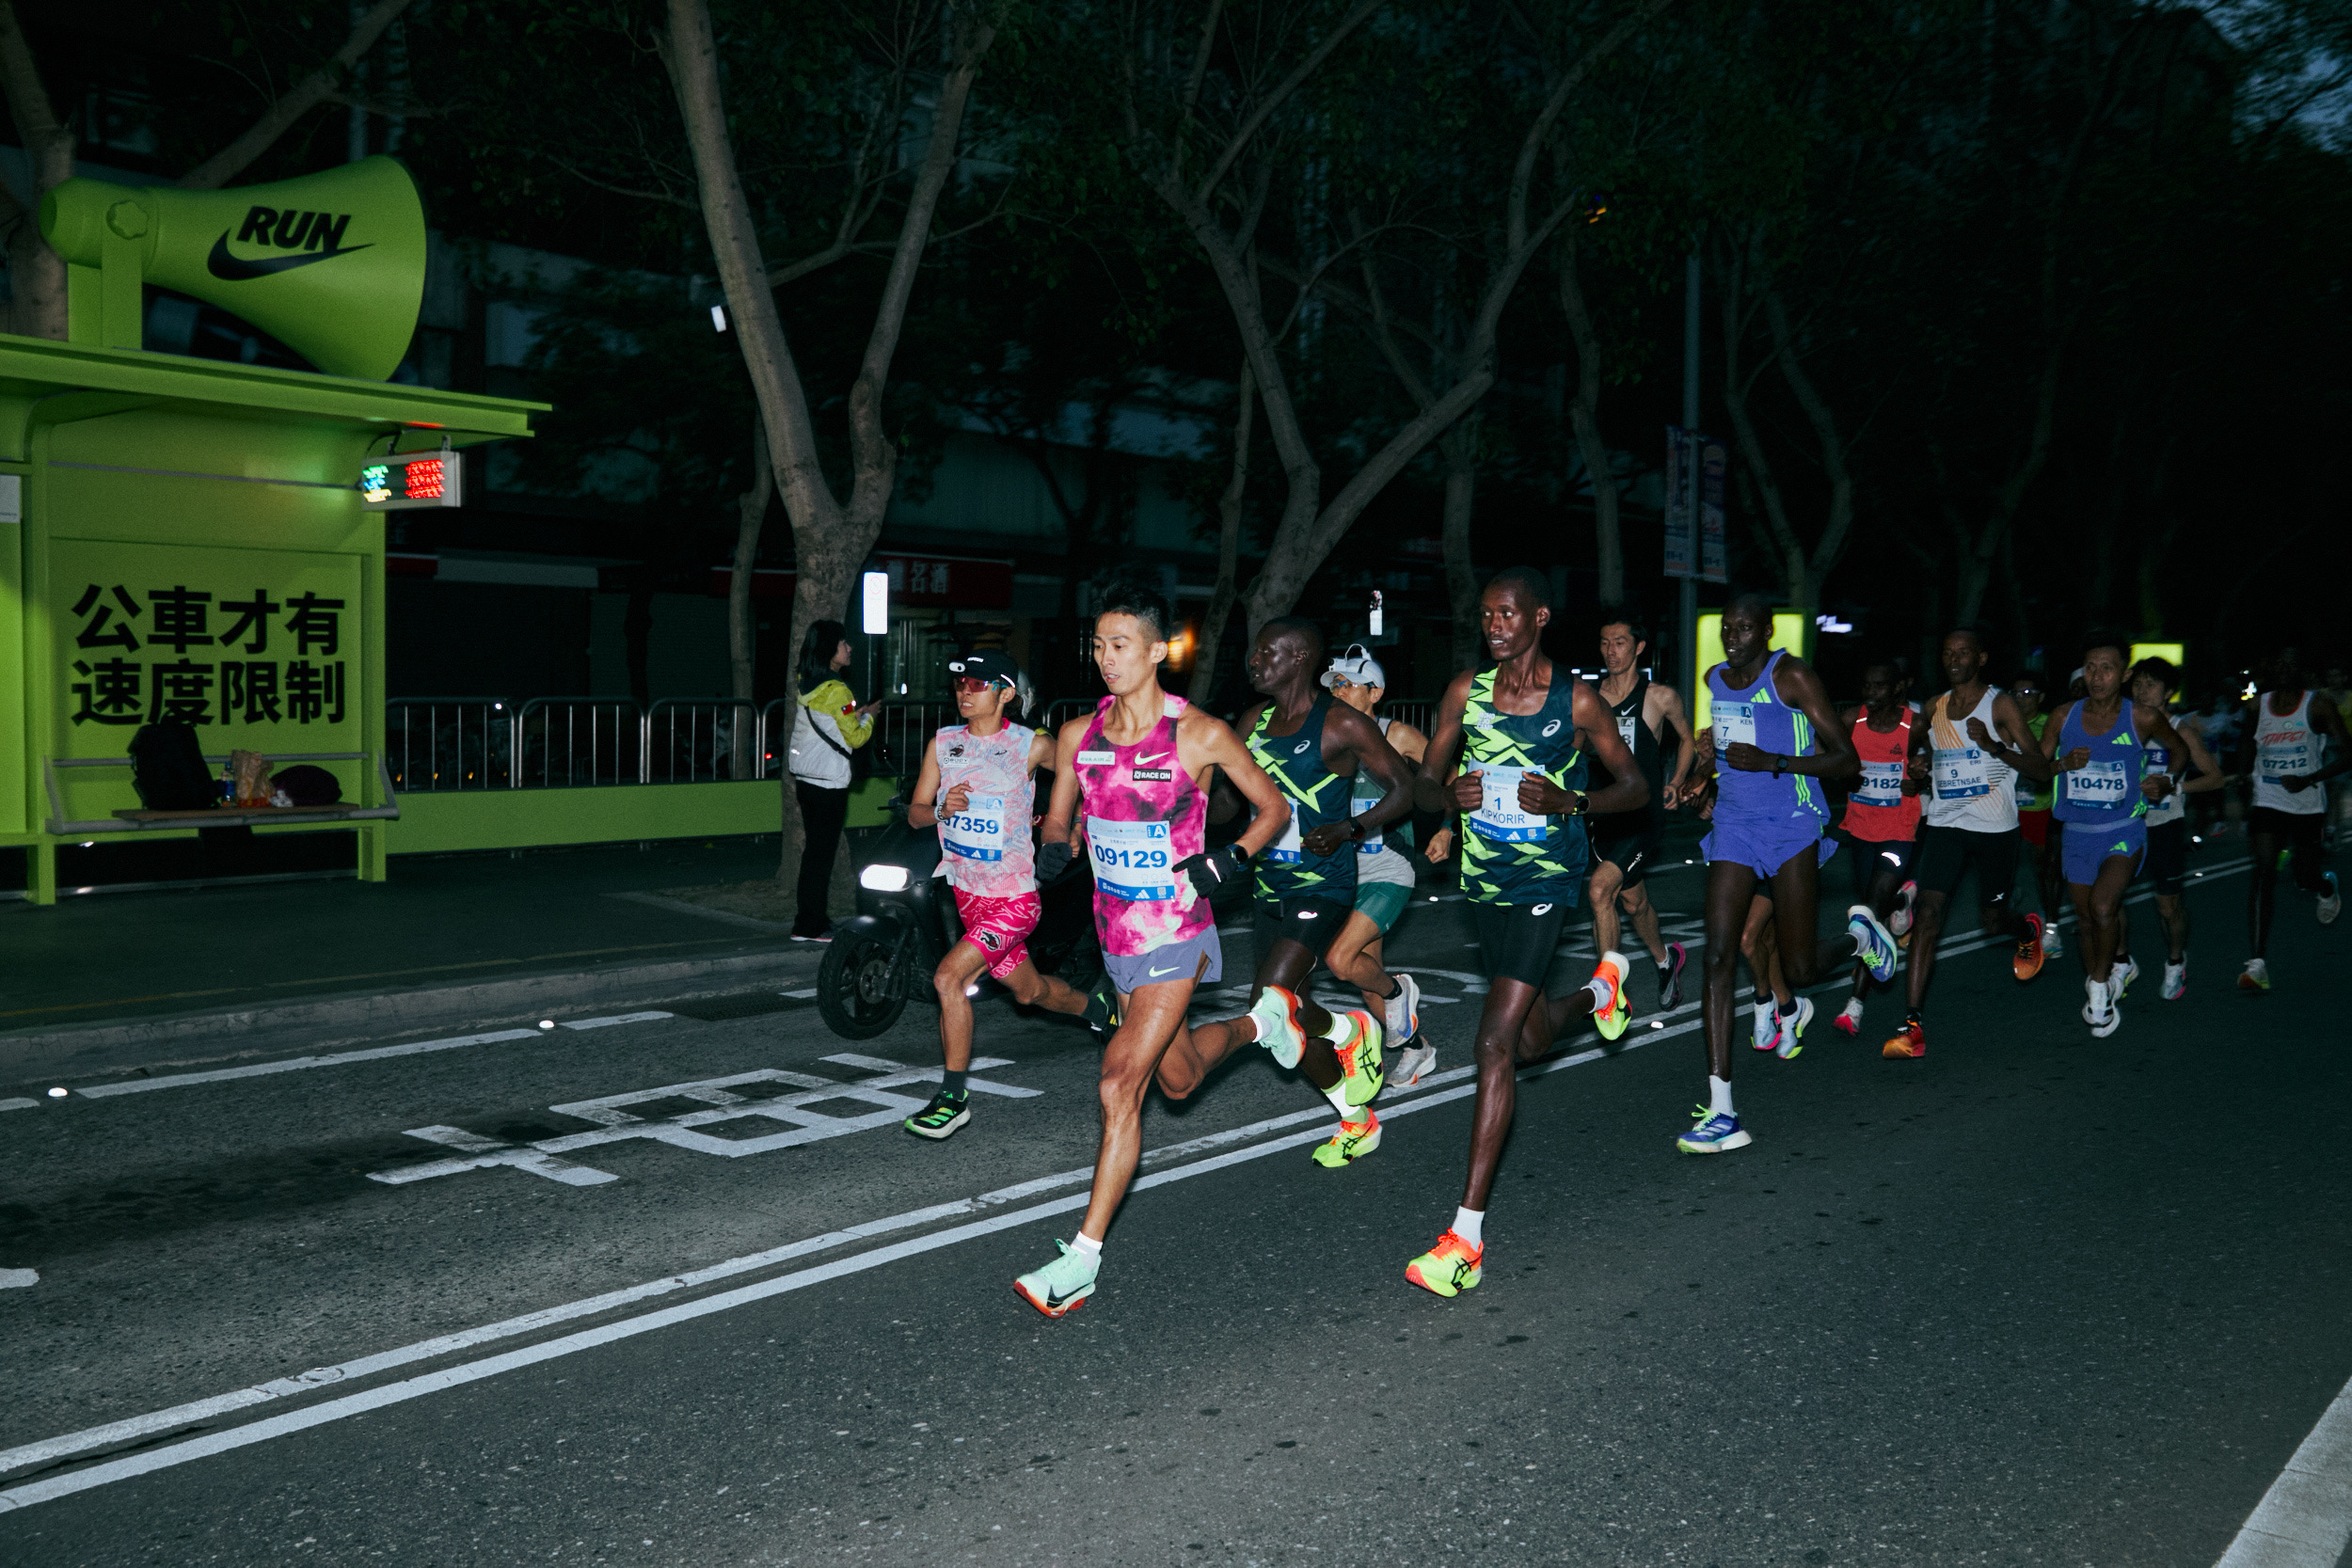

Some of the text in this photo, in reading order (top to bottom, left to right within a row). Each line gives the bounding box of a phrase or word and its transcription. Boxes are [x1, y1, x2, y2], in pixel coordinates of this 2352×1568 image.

[236, 206, 352, 252] RUN
[72, 584, 345, 656] 公車才有
[71, 657, 345, 726] 速度限制
[1723, 726, 1729, 737] 7
[2263, 758, 2307, 769] 07212
[1950, 768, 1958, 779] 9
[2071, 777, 2124, 790] 10478
[1494, 797, 1501, 810] 1
[1481, 809, 1525, 824] KIPKORIR
[1095, 845, 1168, 868] 09129
